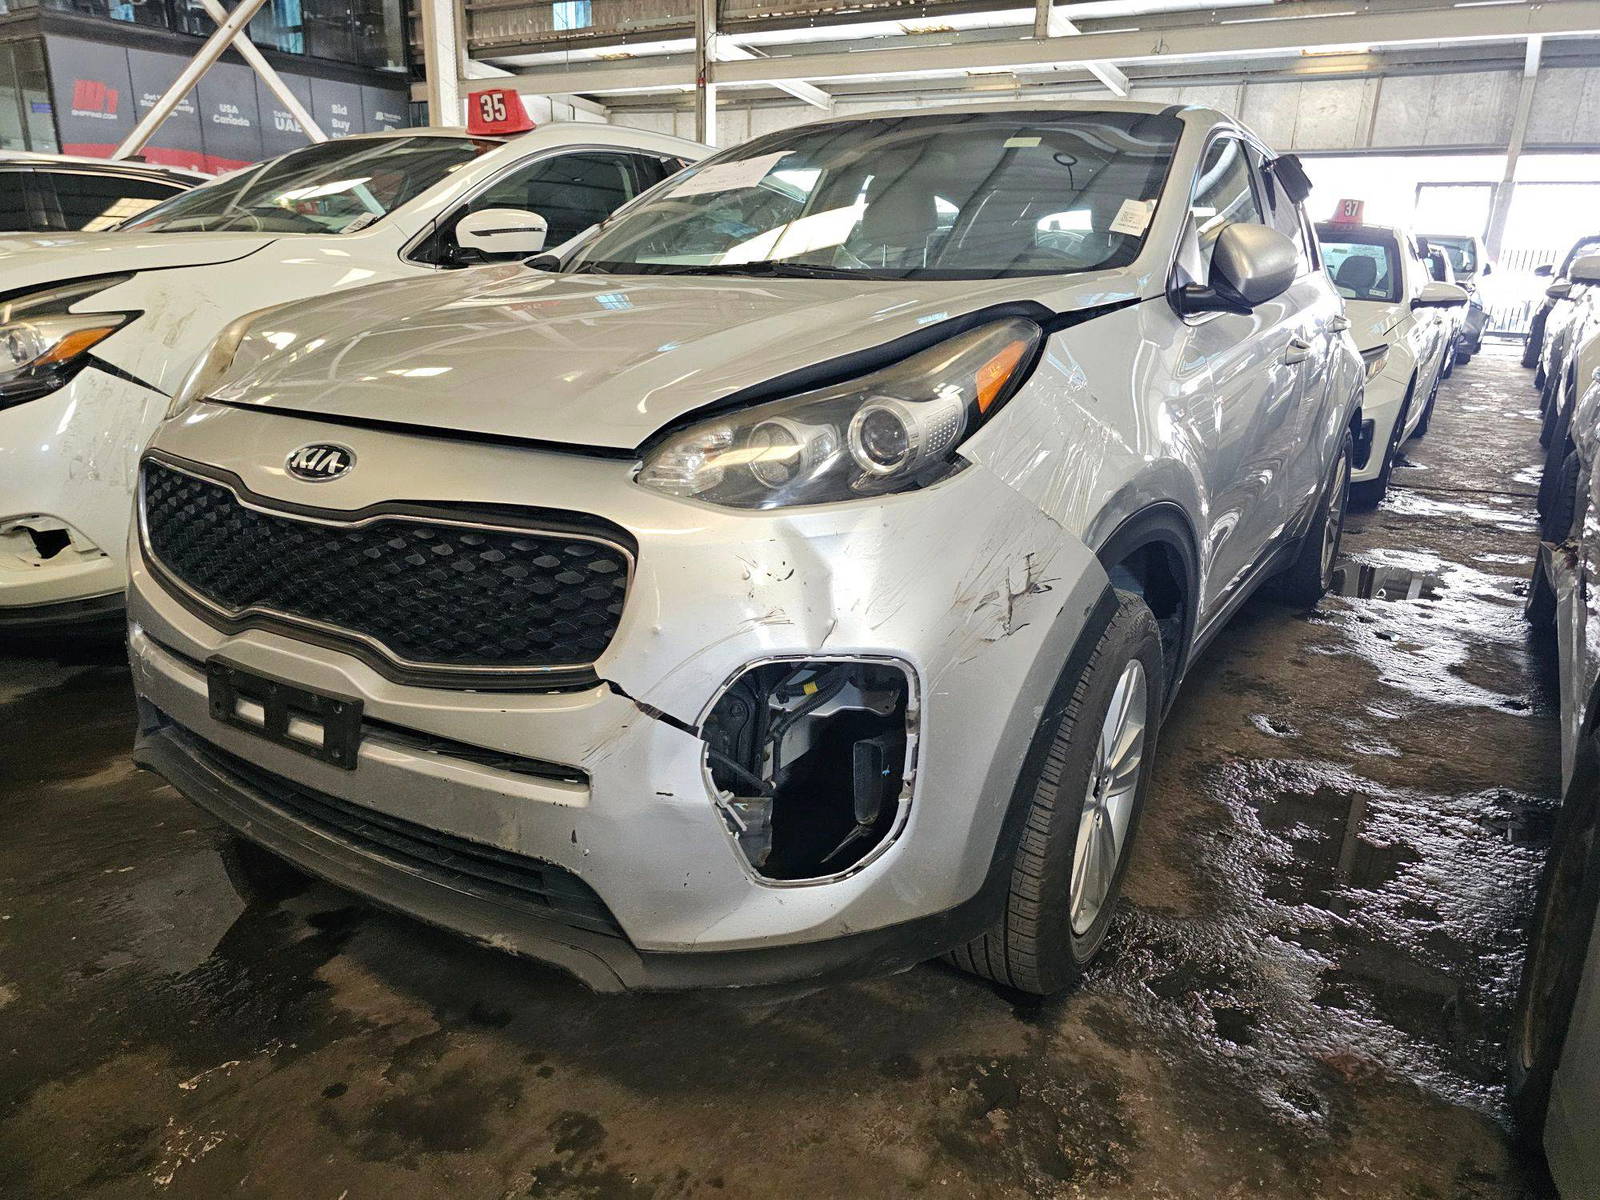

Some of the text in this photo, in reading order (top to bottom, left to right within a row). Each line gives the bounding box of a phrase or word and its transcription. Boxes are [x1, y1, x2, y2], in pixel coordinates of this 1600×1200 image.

[219, 103, 239, 114] USA
[331, 104, 348, 115] Bid
[480, 93, 507, 122] 35
[213, 114, 250, 127] Canada
[331, 118, 351, 132] Buy
[1344, 200, 1360, 217] 37
[291, 447, 344, 474] KIA
